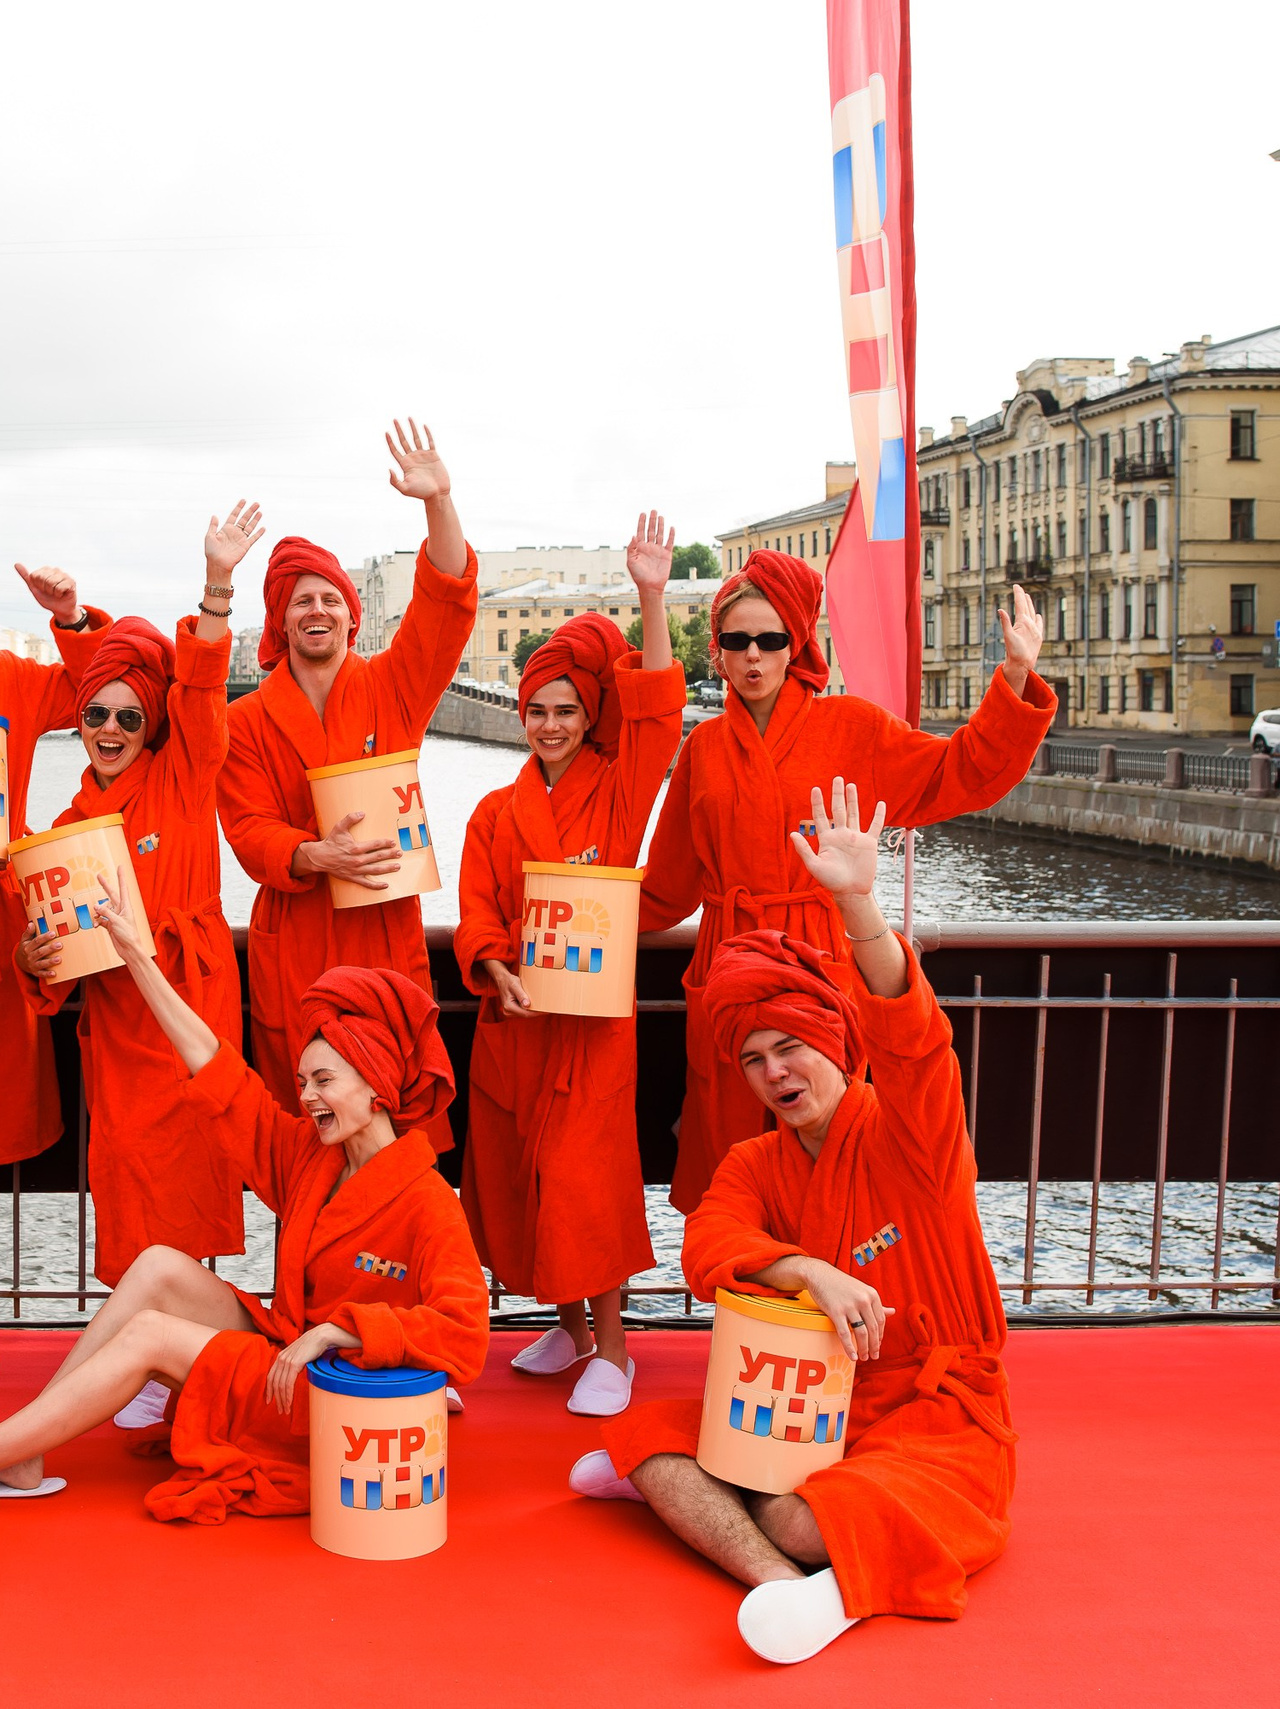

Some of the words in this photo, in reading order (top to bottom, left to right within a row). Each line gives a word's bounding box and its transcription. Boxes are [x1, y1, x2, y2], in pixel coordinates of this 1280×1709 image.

[354, 1251, 408, 1282] ТНТ
[851, 1222, 902, 1267] ТНТ
[729, 1384, 846, 1444] ТНТ
[340, 1455, 445, 1511] ТНТ
